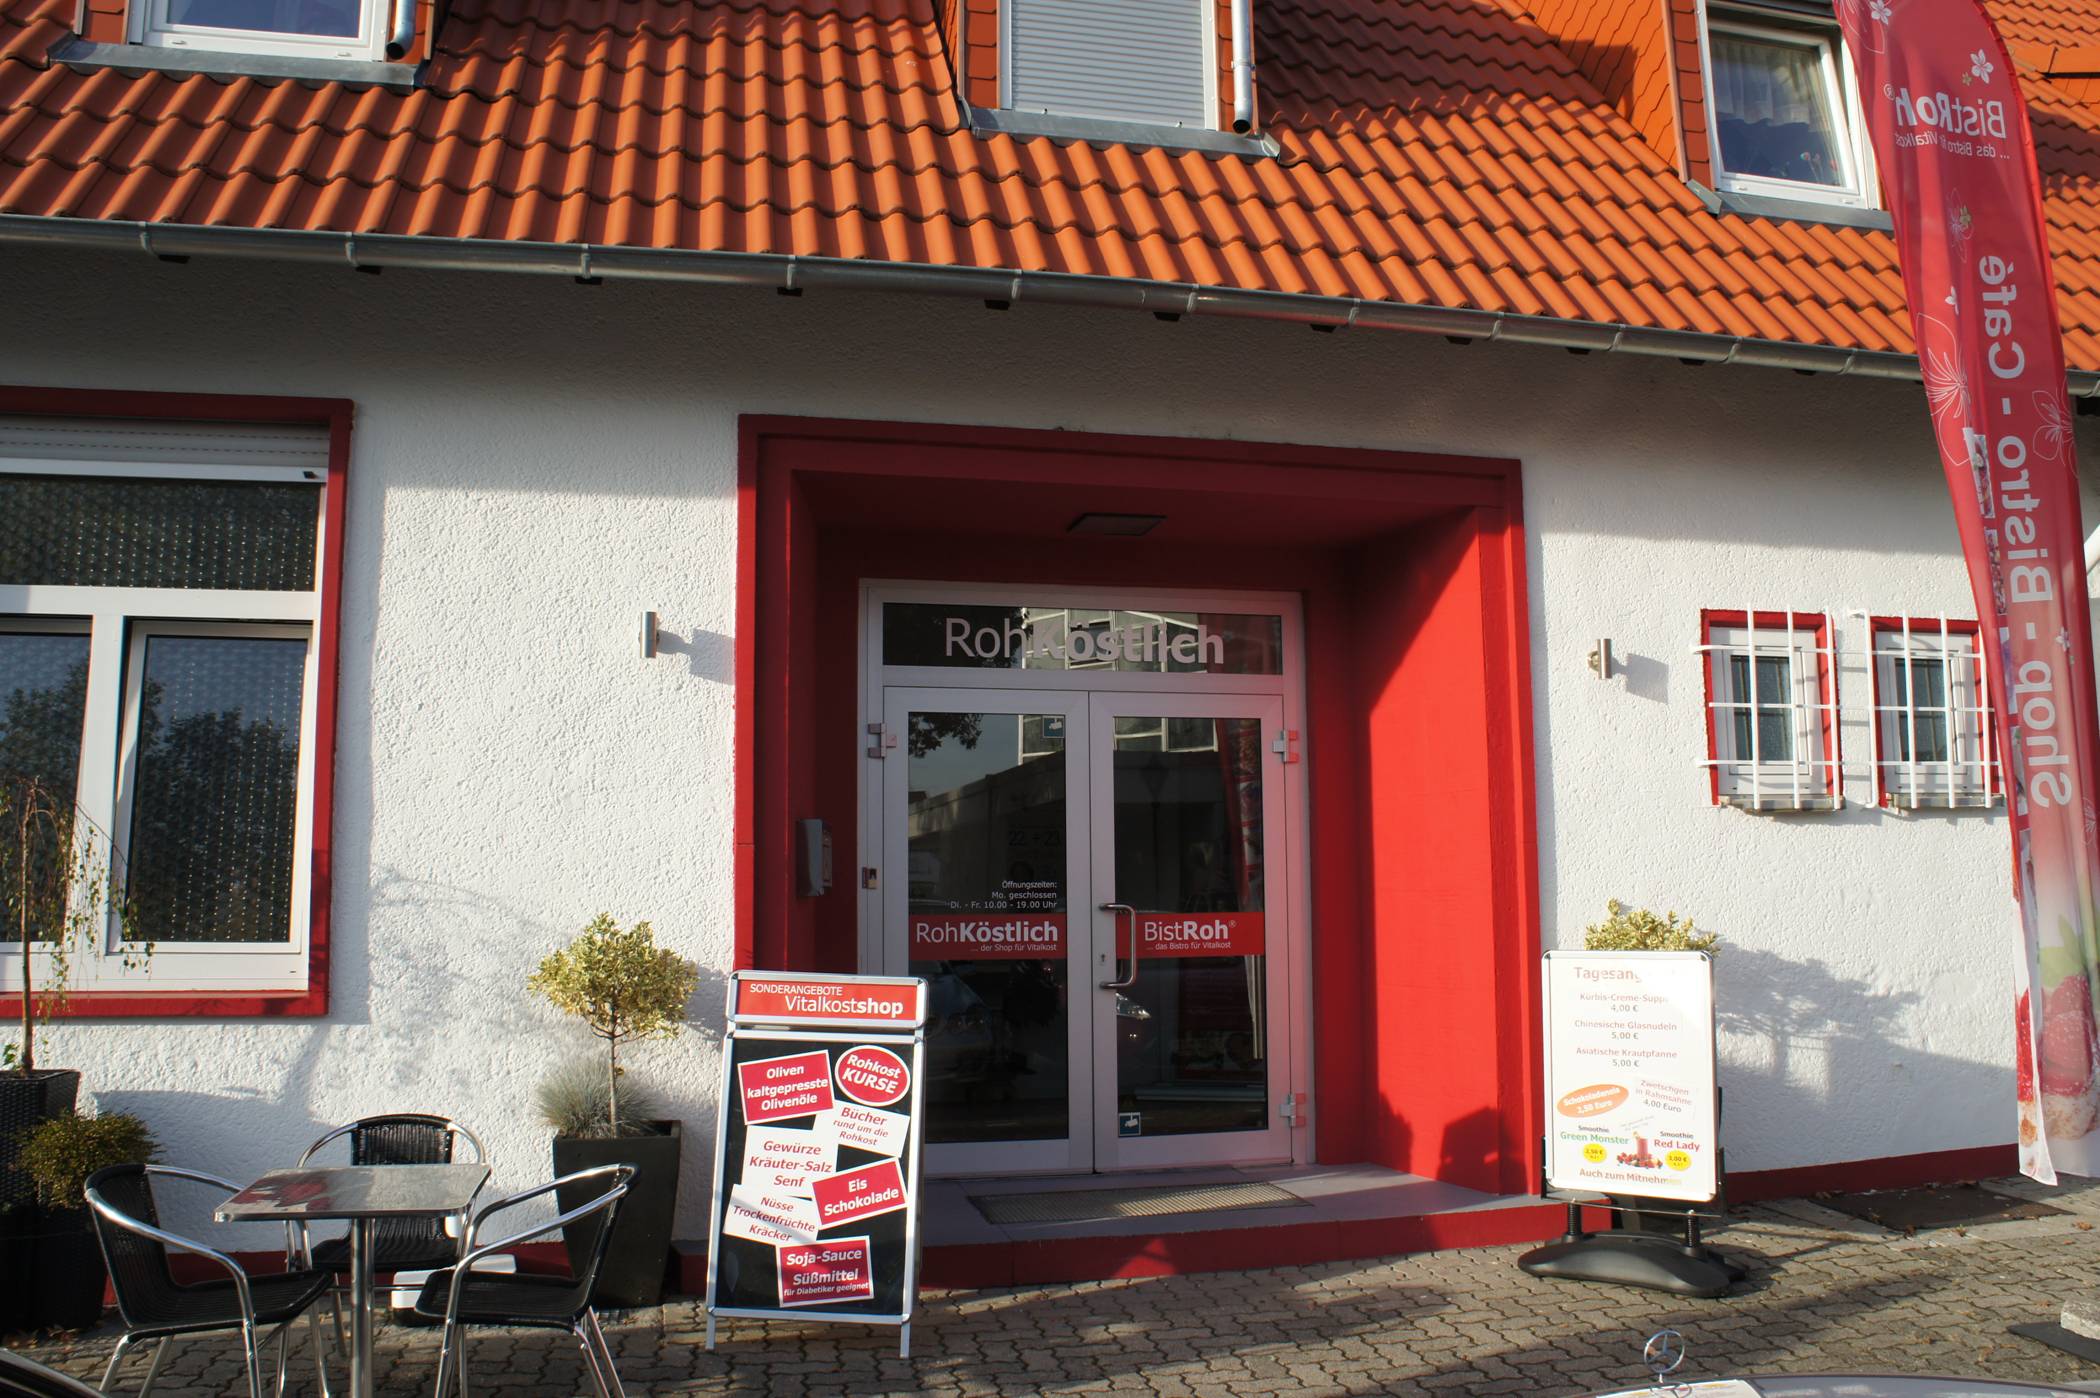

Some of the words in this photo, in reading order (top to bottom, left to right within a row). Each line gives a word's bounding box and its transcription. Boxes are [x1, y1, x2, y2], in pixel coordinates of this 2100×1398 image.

[945, 617, 1224, 665] RohKöstlich
[1001, 880, 1057, 890] Öffnungszeiten:
[991, 891, 1007, 899] Mo.
[1009, 891, 1057, 900] geschlossen
[950, 901, 962, 909] Di.
[971, 901, 982, 909] Fr.
[984, 901, 1007, 909] 10.00
[1016, 901, 1040, 909] 19.00
[1042, 901, 1057, 909] Uhr
[916, 921, 1058, 943] RohKöstlich
[980, 944, 993, 952] der
[995, 944, 1013, 953] Shop
[1014, 944, 1026, 952] für
[1027, 943, 1057, 952] Vitalkost
[1155, 942, 1168, 950] das
[1169, 942, 1189, 950] Bistro
[1190, 942, 1201, 950] für
[1202, 941, 1231, 950] Vitalkost
[750, 983, 843, 996] SONDERANGEBOTE
[785, 995, 904, 1018] Vitalkostshop
[1611, 1004, 1631, 1012] 4,00
[1632, 1004, 1639, 1012] €
[1574, 1019, 1625, 1029] Chinesische
[1627, 1021, 1678, 1031] Glasnudeln
[1611, 1031, 1631, 1040] 5,00
[1633, 1032, 1639, 1040] €
[1576, 1047, 1621, 1056] Asiatische
[1622, 1049, 1678, 1059] Krautpfanne
[847, 1054, 901, 1079] Rohkost
[1612, 1059, 1631, 1067] 5,00
[766, 1064, 804, 1079] Oliven
[747, 1077, 829, 1099] kaltgepresste
[842, 1068, 899, 1095] KURSE
[761, 1093, 818, 1111] Olivenöle
[1662, 1102, 1682, 1113] Euro
[840, 1106, 887, 1126] Bücher
[833, 1119, 855, 1132] rund
[857, 1125, 871, 1134] um
[873, 1127, 889, 1138] die
[1578, 1125, 1609, 1133] Smoothie
[1660, 1131, 1694, 1140] Smoothie
[839, 1130, 878, 1146] Rohkost
[1560, 1131, 1588, 1142] Green
[1590, 1133, 1629, 1145] Monster
[763, 1139, 821, 1156] Gewürze
[1654, 1139, 1674, 1149] Red
[1676, 1140, 1700, 1152] Lady
[749, 1156, 832, 1173] Kräuter-Salz
[773, 1174, 804, 1187] Senf
[1579, 1168, 1603, 1178] Auch
[1605, 1172, 1625, 1181] zum
[848, 1179, 868, 1193] Eis
[760, 1196, 794, 1212] Nüsse
[824, 1188, 900, 1217] Schokolade
[733, 1205, 816, 1233] Trockenfrüchte
[749, 1224, 793, 1243] Kräcker
[786, 1248, 862, 1266] Soja-Sauce
[793, 1268, 859, 1286] Süßmittel
[784, 1288, 795, 1296] für
[796, 1285, 835, 1296] Diabetiker
[836, 1282, 869, 1295] geeignet
